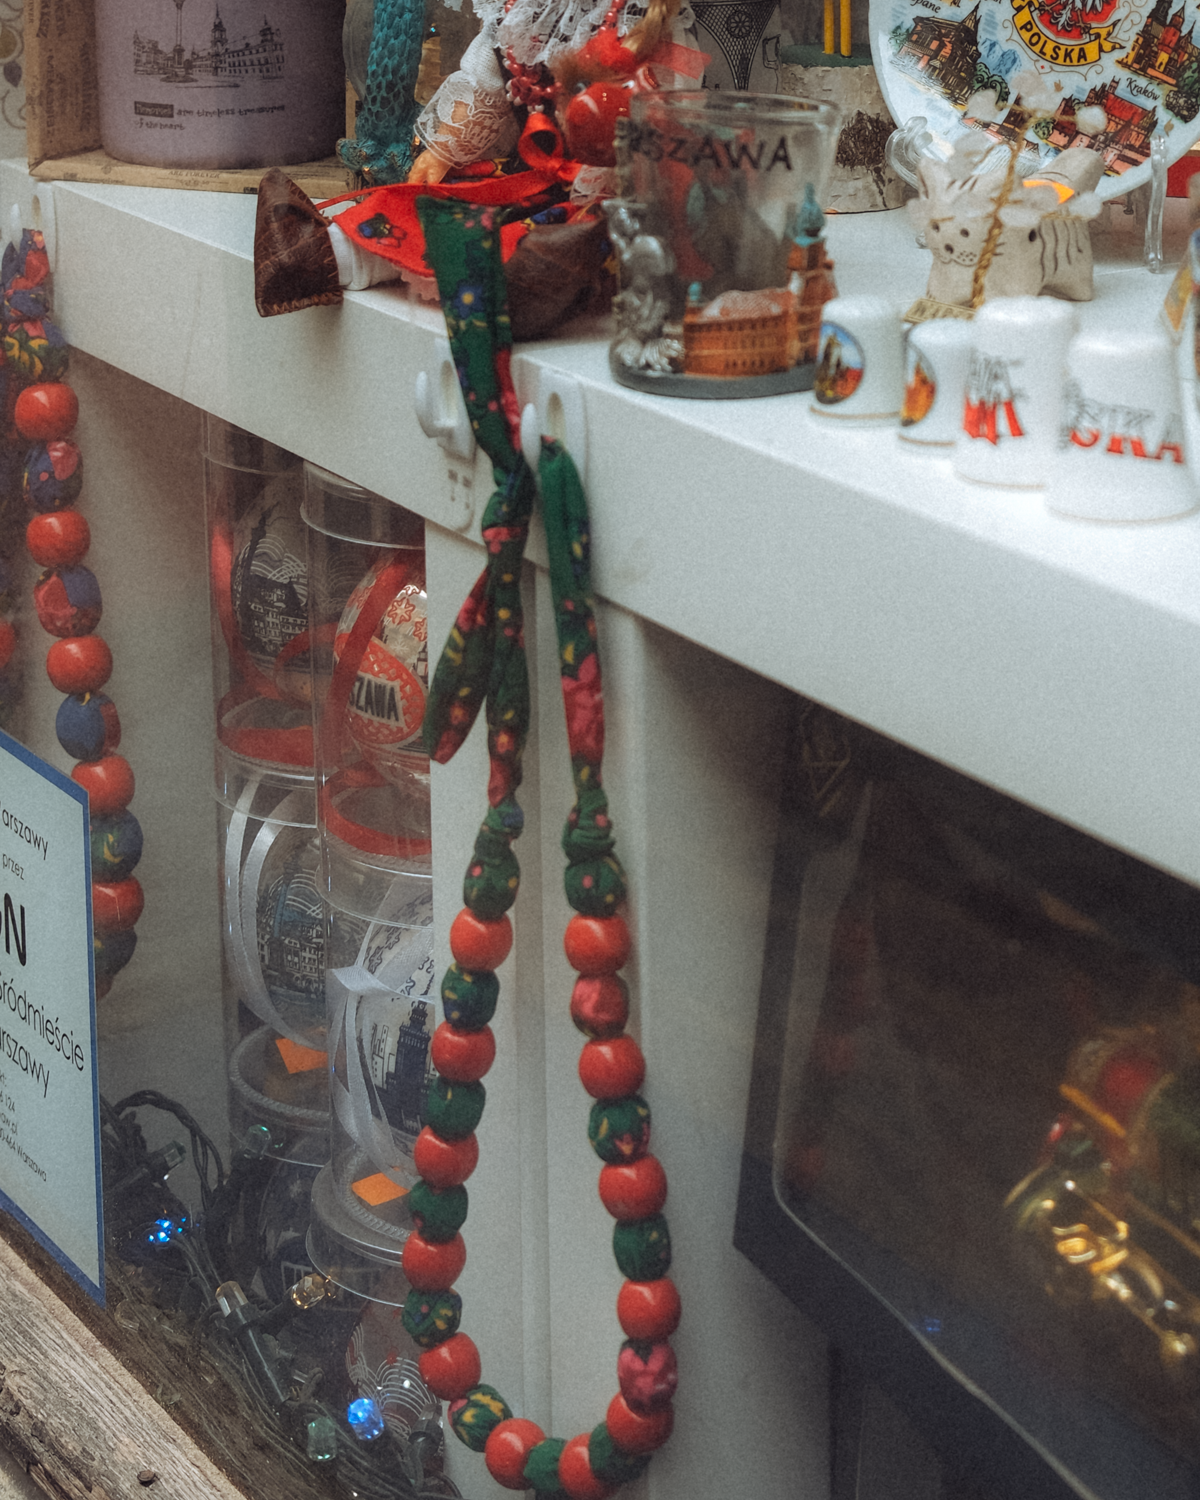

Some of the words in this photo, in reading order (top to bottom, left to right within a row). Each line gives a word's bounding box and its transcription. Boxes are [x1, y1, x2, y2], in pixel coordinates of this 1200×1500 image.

[1019, 20, 1088, 64] POLSKA
[1126, 77, 1161, 101] Kraków
[0, 802, 49, 861] arszawy
[0, 892, 27, 968] N
[0, 972, 85, 1072] ródmieście
[0, 1025, 50, 1099] rszawy
